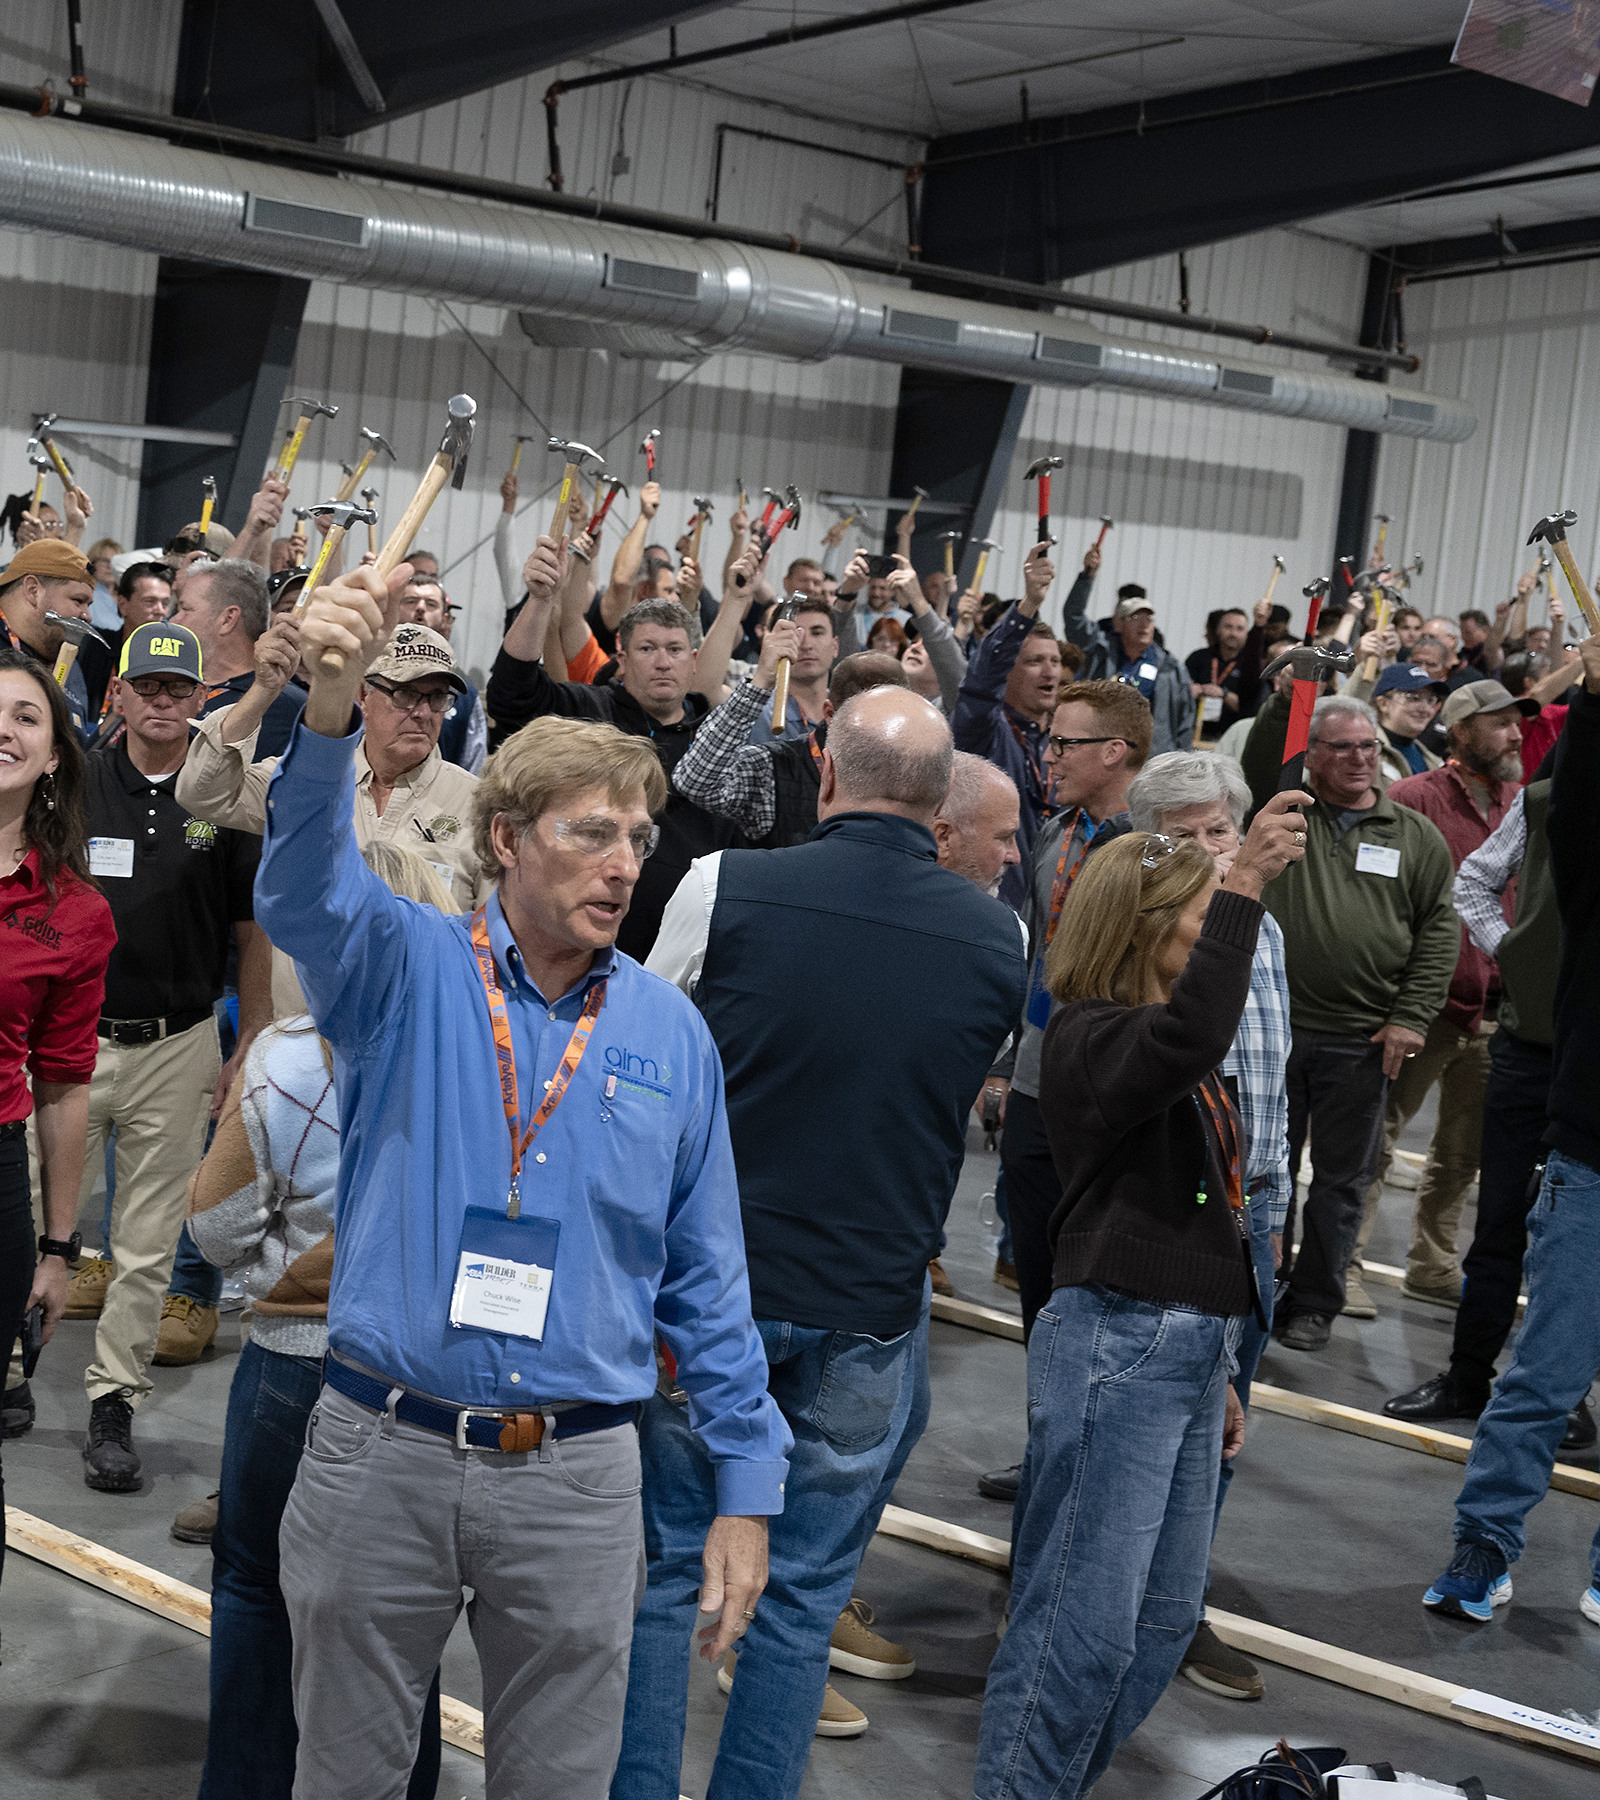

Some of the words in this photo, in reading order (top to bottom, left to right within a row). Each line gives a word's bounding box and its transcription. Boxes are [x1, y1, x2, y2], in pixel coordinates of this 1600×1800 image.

[150, 637, 184, 657] CAT
[24, 916, 64, 946] GUIDE
[605, 1046, 658, 1081] aim
[499, 1063, 515, 1104] Artelye
[541, 1077, 565, 1118] Artelye
[485, 1264, 516, 1279] BUILDER
[483, 1290, 502, 1300] Chuck
[505, 1295, 521, 1304] Wise
